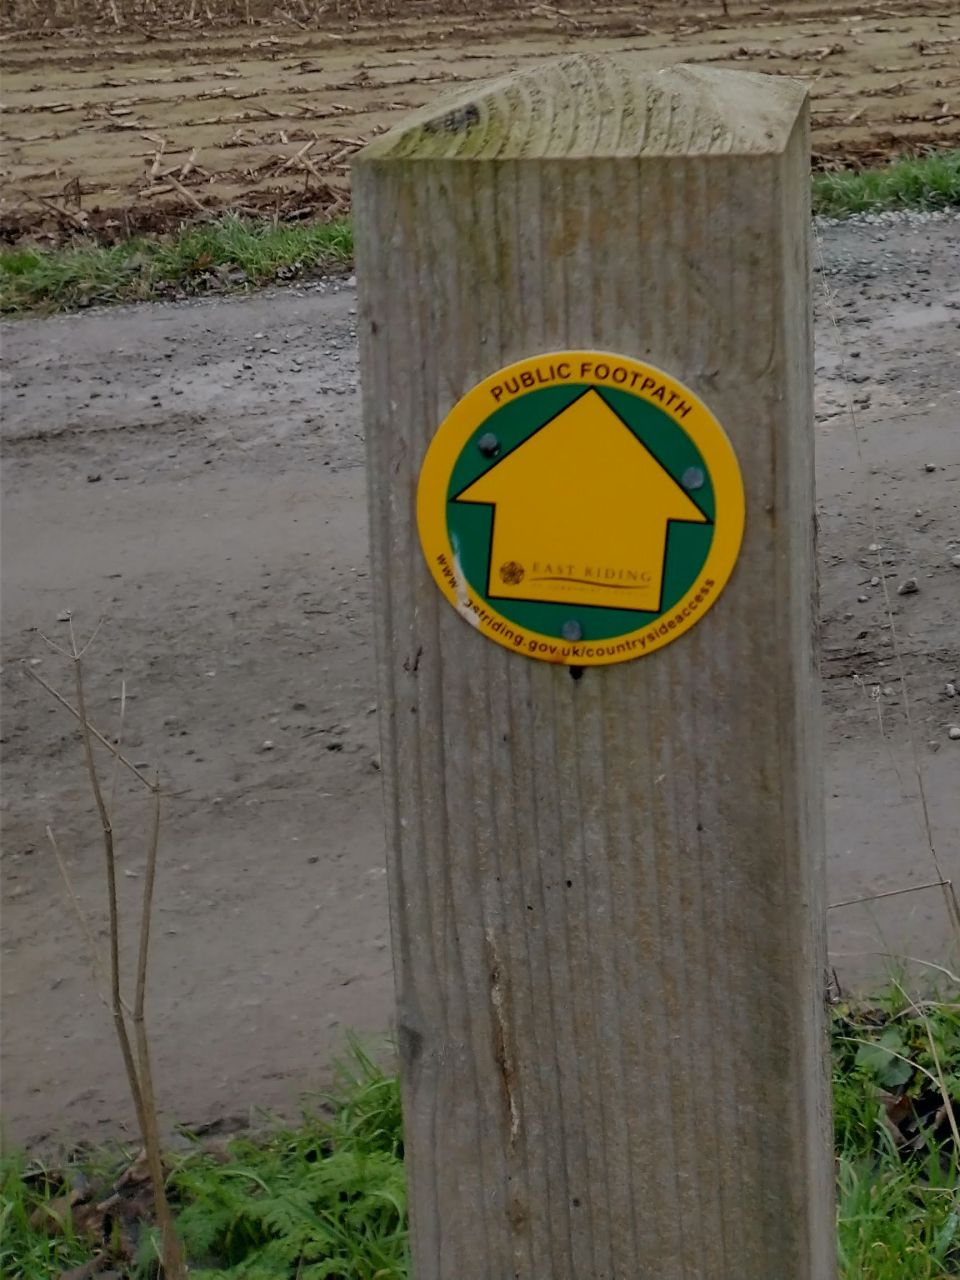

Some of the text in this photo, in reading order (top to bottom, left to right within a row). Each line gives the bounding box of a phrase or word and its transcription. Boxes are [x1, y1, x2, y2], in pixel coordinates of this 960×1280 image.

[490, 362, 693, 419] PUBLIC FOOTPATH
[532, 562, 652, 582] EAST RIDING
